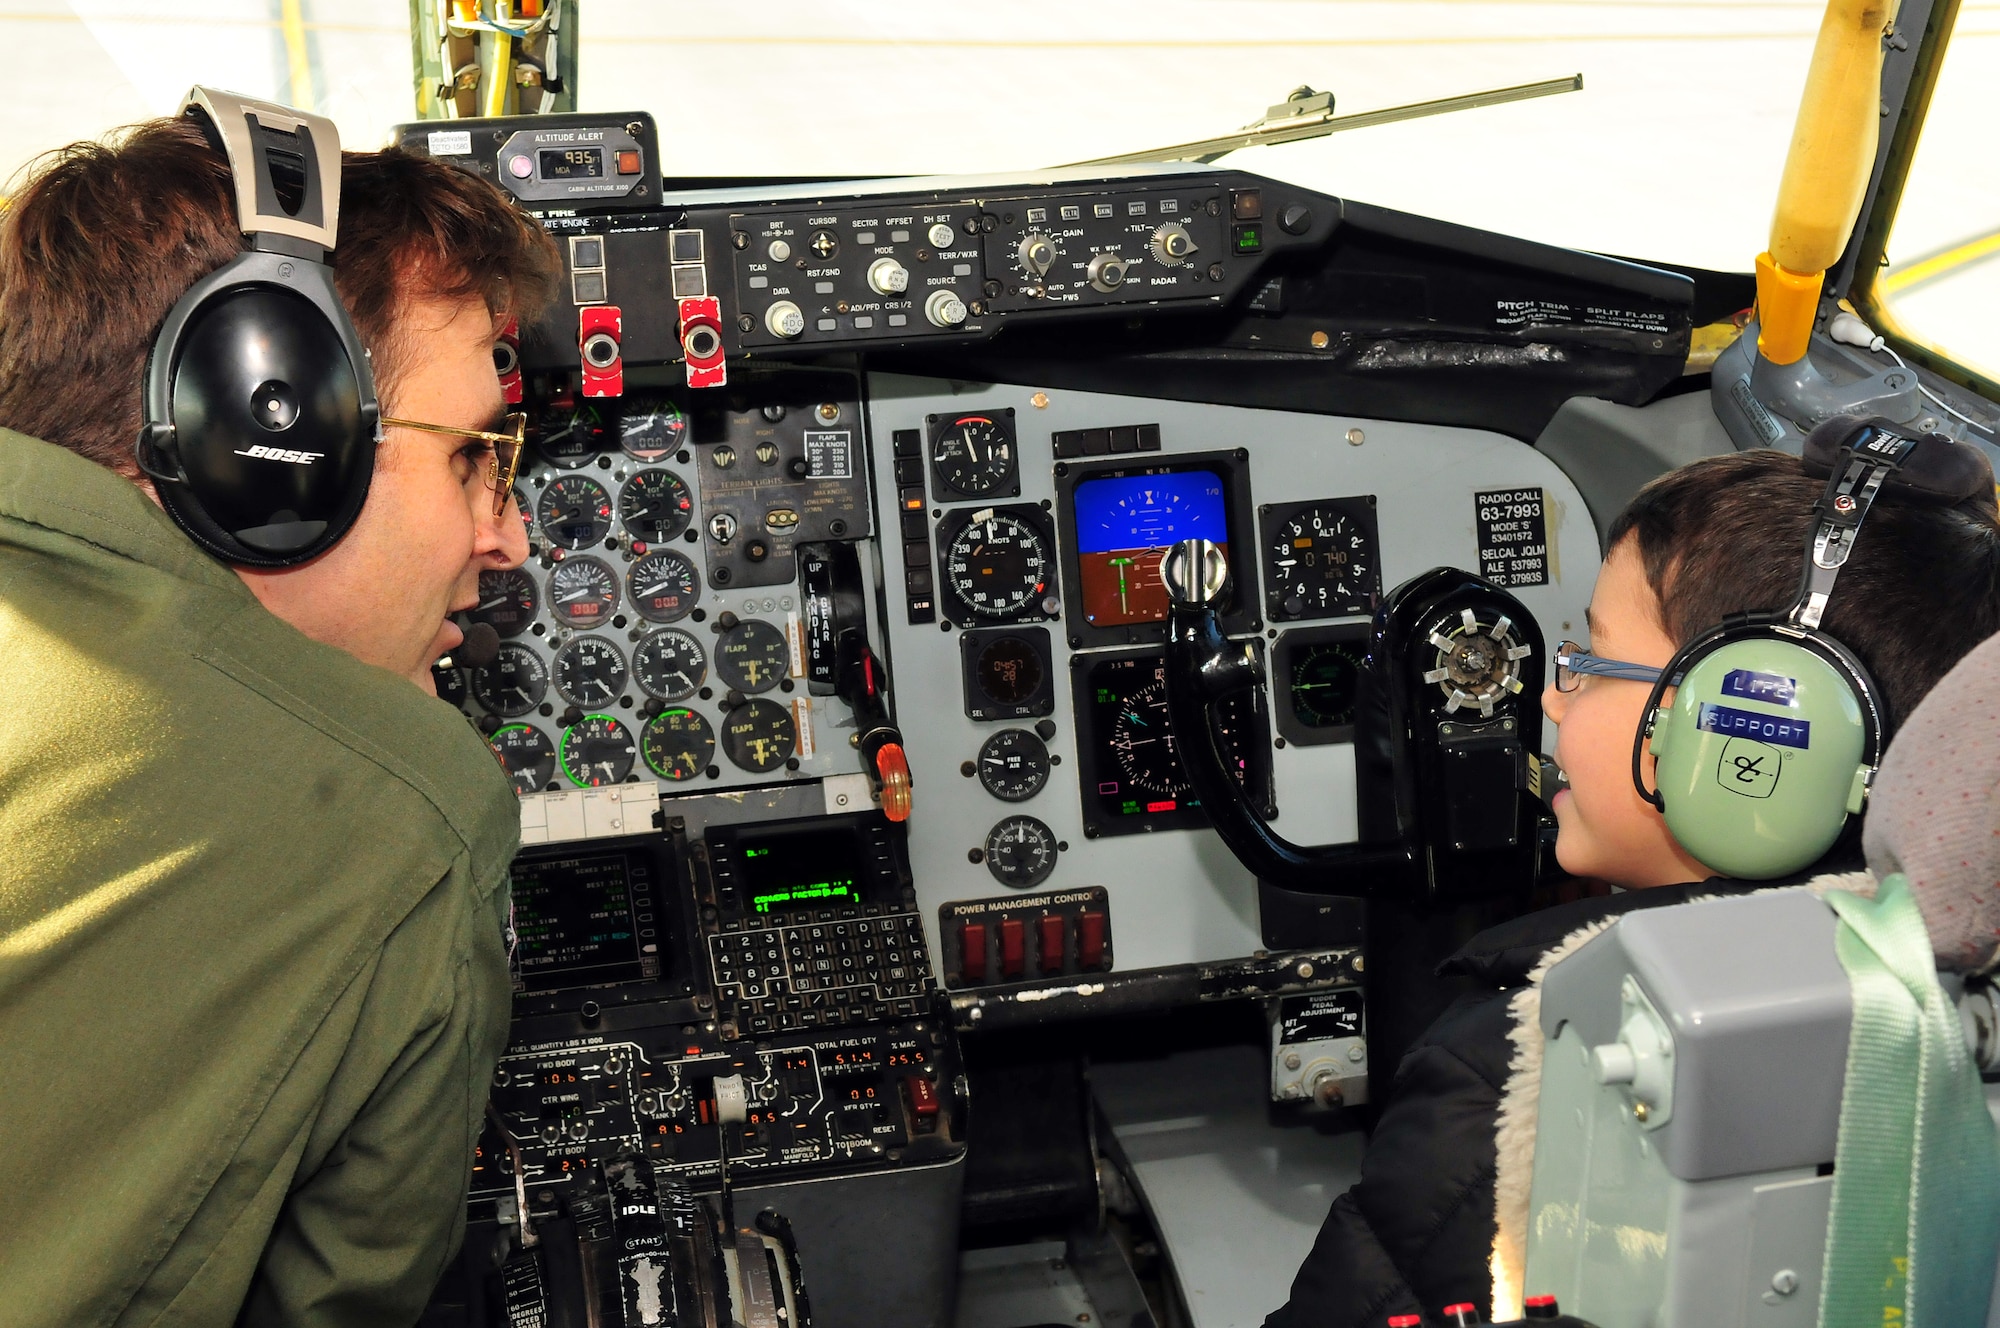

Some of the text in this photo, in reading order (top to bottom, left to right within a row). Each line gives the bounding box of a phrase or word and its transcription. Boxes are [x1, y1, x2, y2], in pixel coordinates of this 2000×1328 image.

[535, 132, 604, 142] ALTITUDE ALERT
[565, 151, 592, 164] 935
[1097, 207, 1111, 216] SKIN
[1130, 205, 1144, 214] AUTO
[560, 218, 590, 227] ENGINE
[808, 217, 837, 225] CURSOR
[852, 219, 878, 227] SECTOR
[886, 217, 914, 225] OFFSET
[936, 214, 951, 222] SET
[770, 222, 784, 230] BRT
[1131, 224, 1146, 232] TILT
[1063, 229, 1084, 237] GAIN
[938, 251, 978, 260] TERR/WXR
[807, 268, 840, 278] RST/SND
[927, 277, 956, 286] SOURCE
[1151, 277, 1178, 285] RADAR
[1062, 293, 1080, 301] PWS
[850, 303, 880, 312] ADI/PFD
[884, 301, 912, 310] CRS 1/2
[1497, 300, 1666, 320] PITCH TRIM SPLIT FLAPS
[1646, 324, 1668, 333] DOWN
[234, 444, 324, 466] BOSE
[721, 478, 783, 489] TERRAIN LIGHTS
[1479, 491, 1540, 504] RADIO CALL
[1480, 503, 1540, 520] 63-7993
[1490, 522, 1519, 532] MODE
[968, 530, 982, 540] 400
[1319, 528, 1335, 538] ALT
[1491, 531, 1532, 543] 53401572
[988, 536, 1010, 545] KNOTS
[1020, 539, 1032, 549] 100
[958, 544, 971, 554] 350
[1482, 545, 1545, 560] SELCAL JQLM
[809, 562, 822, 572] UP
[1027, 558, 1039, 567] 120
[1487, 558, 1542, 573] ALE 537993
[954, 564, 967, 573] 300
[1024, 575, 1036, 584] 140
[1511, 572, 1542, 584] 37993S
[960, 579, 973, 588] 250
[974, 592, 987, 602] 200
[1011, 591, 1024, 600] 160
[993, 598, 1006, 608] 180
[808, 583, 820, 660] LANDING
[820, 597, 830, 642] GEAR
[725, 645, 747, 653] FLAPS
[816, 666, 829, 675] DN
[1732, 676, 1790, 698] LIFE
[731, 725, 754, 733] FLAPS
[1706, 712, 1805, 741] SUPPORT
[954, 904, 985, 916] POWER
[988, 896, 1051, 912] MANAGEMENT
[524, 956, 554, 966] RETURN
[1300, 1007, 1346, 1017] ADJUSTMENT
[1285, 1013, 1358, 1027] AFT FWD
[530, 1042, 564, 1051] QUANTITY
[814, 1037, 877, 1050] TOTAL FUEL QTY
[889, 1052, 924, 1066] 25.5
[536, 1059, 576, 1070] FWD BODY
[787, 1060, 807, 1070] 1.4
[542, 1093, 579, 1104] CTR WING
[873, 1125, 896, 1134] RESET
[850, 1139, 872, 1148] BOOM
[565, 1146, 587, 1155] BODY
[790, 1146, 813, 1154] ENGINE
[562, 1159, 587, 1171] 2.7
[622, 1205, 656, 1215] IDLE
[630, 1238, 657, 1247] START
[512, 1306, 543, 1320] DEGREES
[516, 1316, 540, 1327] SPEED
